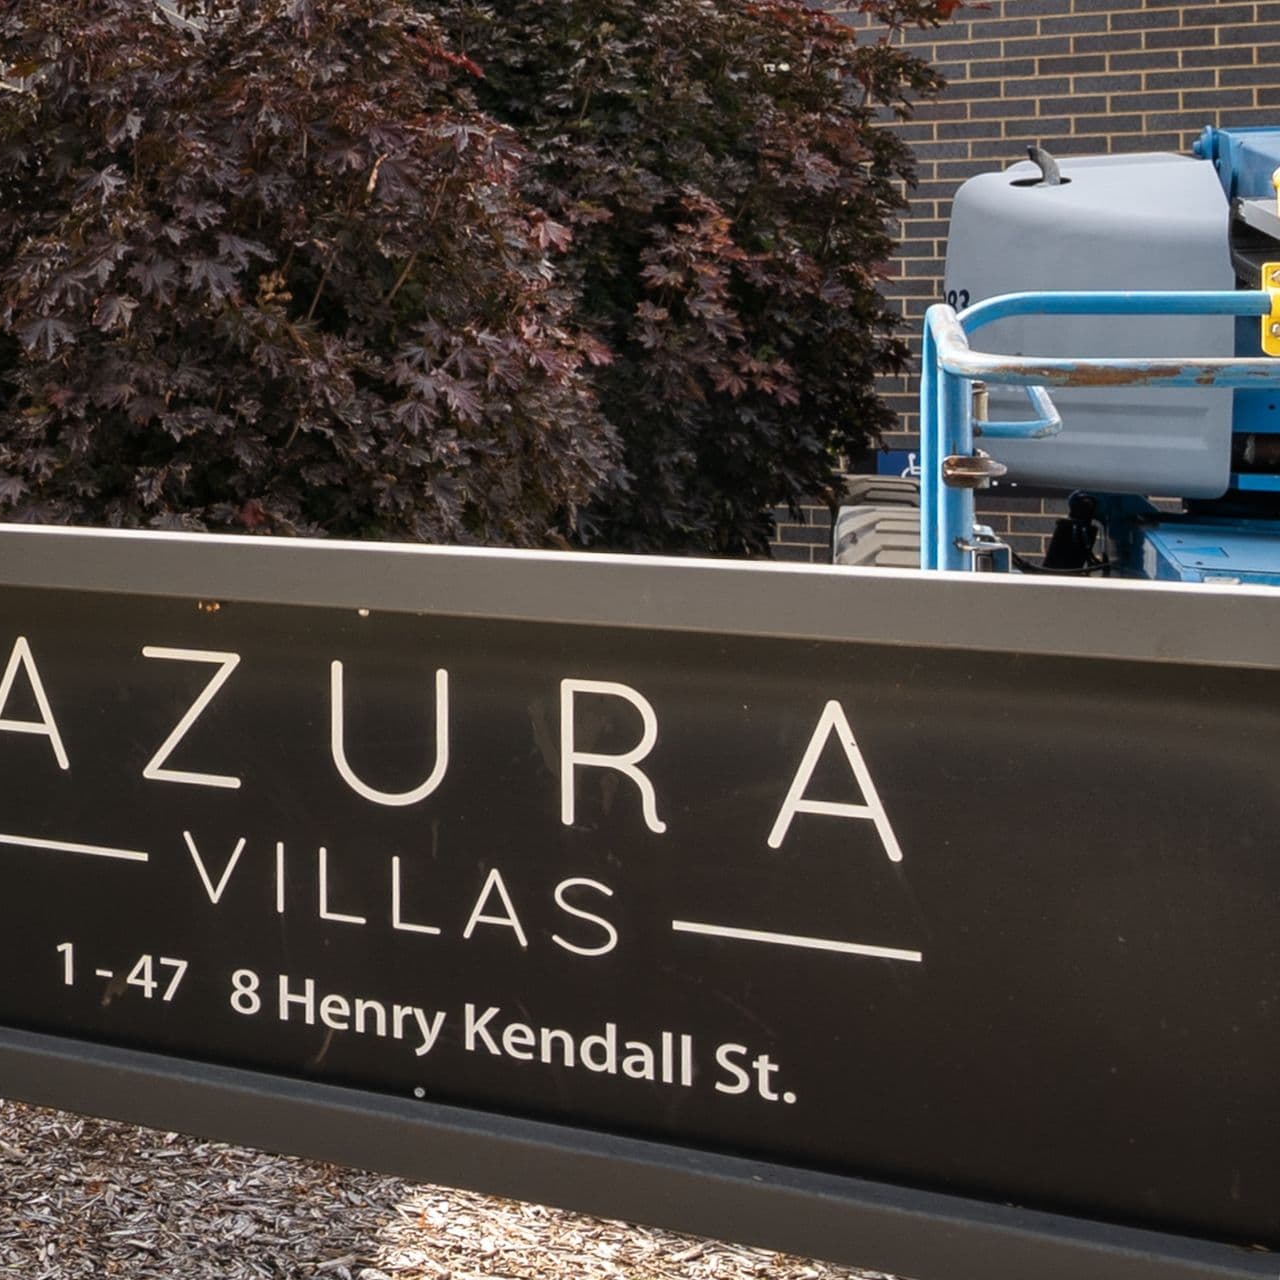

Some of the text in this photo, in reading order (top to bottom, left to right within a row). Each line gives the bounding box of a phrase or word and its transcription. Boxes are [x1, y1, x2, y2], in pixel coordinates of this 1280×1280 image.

[183, 830, 618, 956] VILLAS
[230, 969, 261, 1015] 8
[279, 974, 447, 1057] Henry
[461, 1003, 692, 1087] Kendall
[714, 1043, 797, 1104] St.
